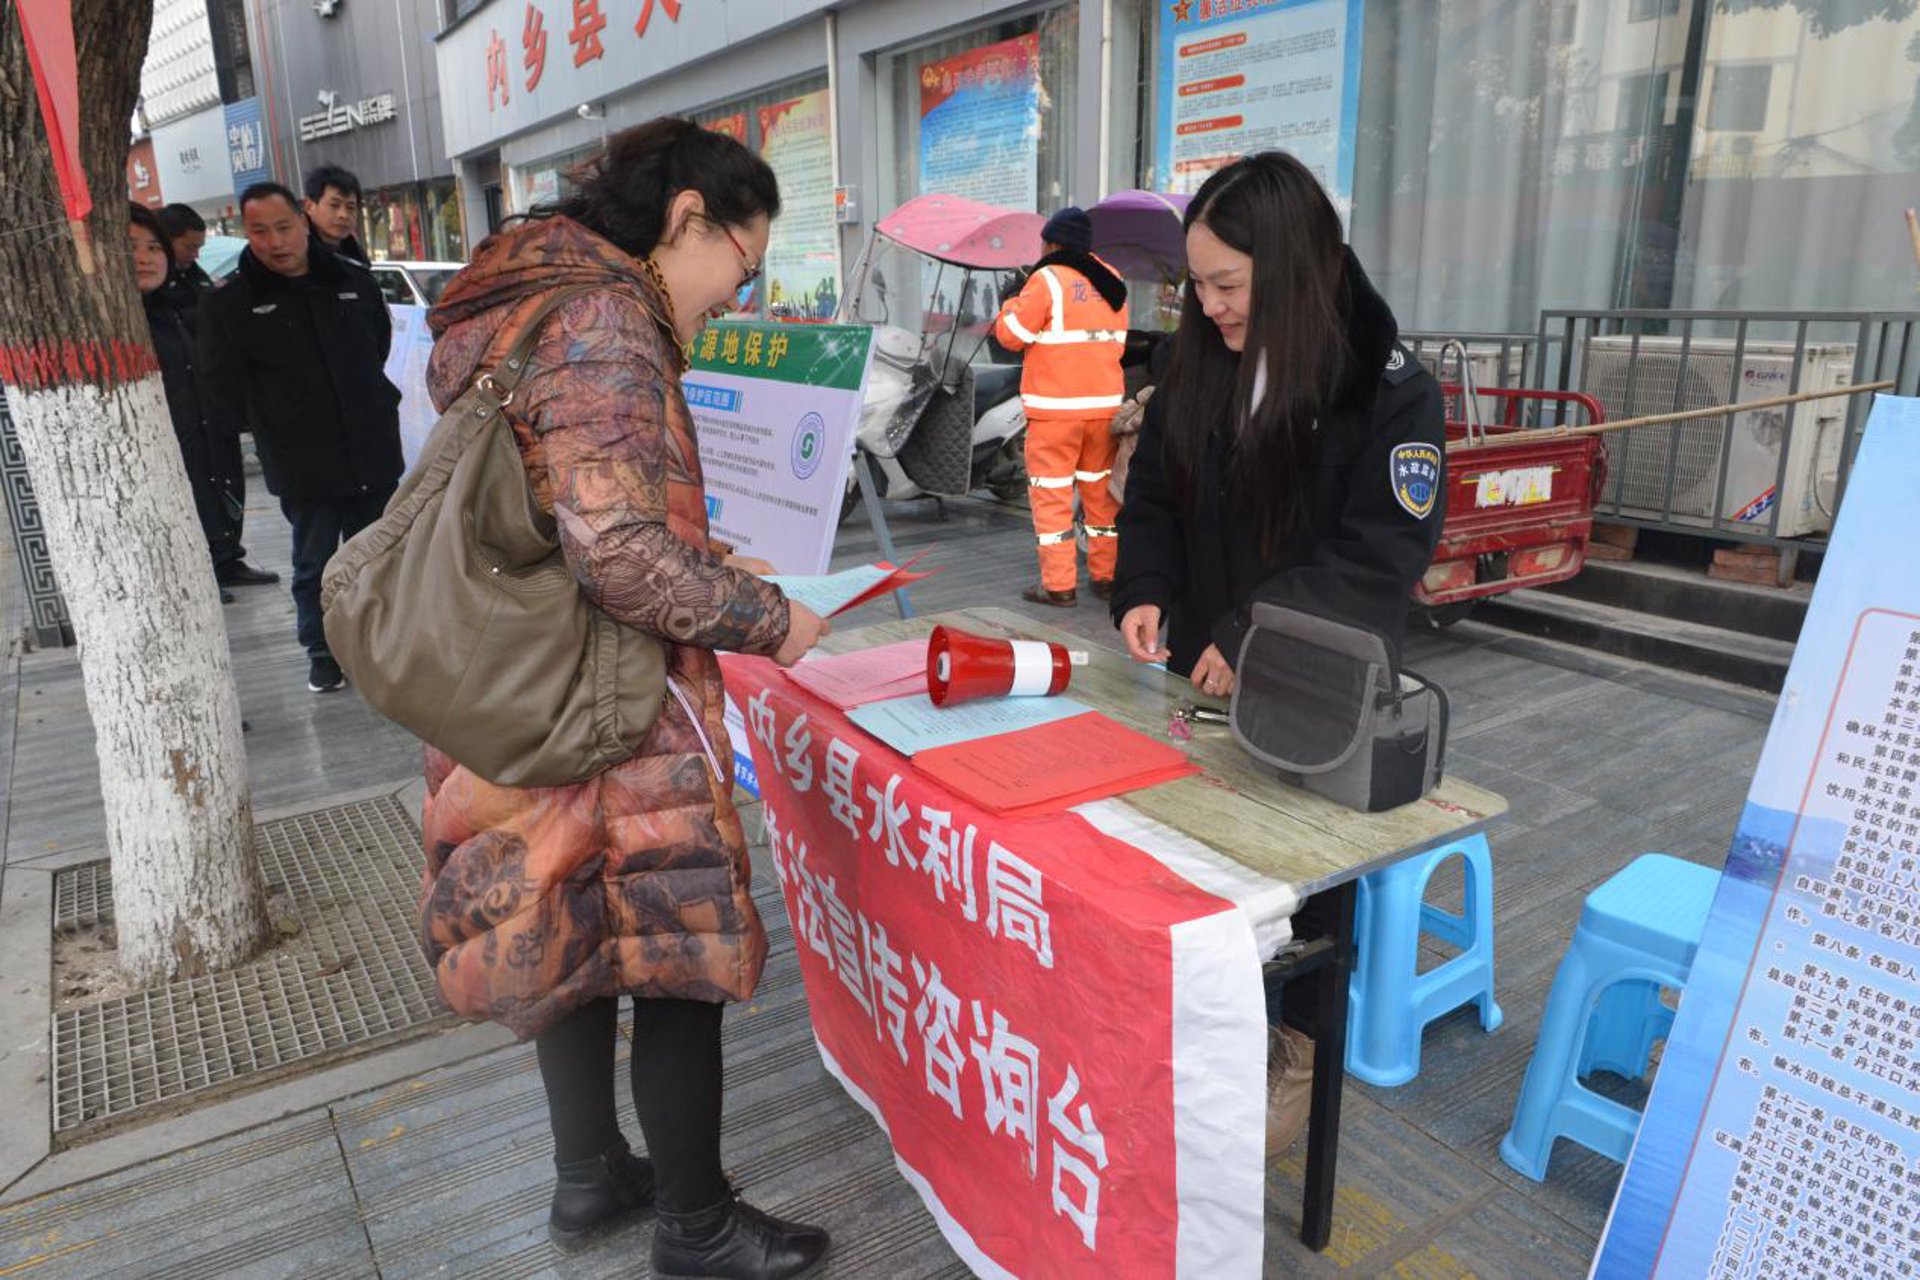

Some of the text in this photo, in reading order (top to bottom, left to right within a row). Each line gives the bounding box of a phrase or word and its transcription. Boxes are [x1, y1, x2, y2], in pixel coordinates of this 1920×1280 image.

[1884, 712, 1920, 731] 第三
[1836, 751, 1917, 783] 和民生保障
[1863, 776, 1912, 799] 第五条
[748, 686, 1054, 968] 内乡县水利局
[1853, 808, 1919, 837] 设区的市
[1843, 840, 1891, 864] 第六条
[1848, 825, 1920, 856] 乡镇人民
[1833, 872, 1920, 910] 县级以上人
[1822, 902, 1871, 928] 第七条
[1812, 933, 1860, 960] 第八条
[1803, 963, 1849, 990] 第九条
[1767, 967, 1920, 1038] 县级以上人民政府应
[1788, 1010, 1834, 1037] 第十条
[1794, 994, 1914, 1050] 第二章 水源保护
[1783, 1025, 1846, 1060] 第十一条
[1764, 1085, 1826, 1121] 第十二条
[1754, 1116, 1814, 1152] 第十三条
[1740, 1160, 1800, 1198] 第十四条
[1729, 1190, 1789, 1229] 第十五条
[1734, 1175, 1920, 1278] 输水沿线总干渠调蓄工程
